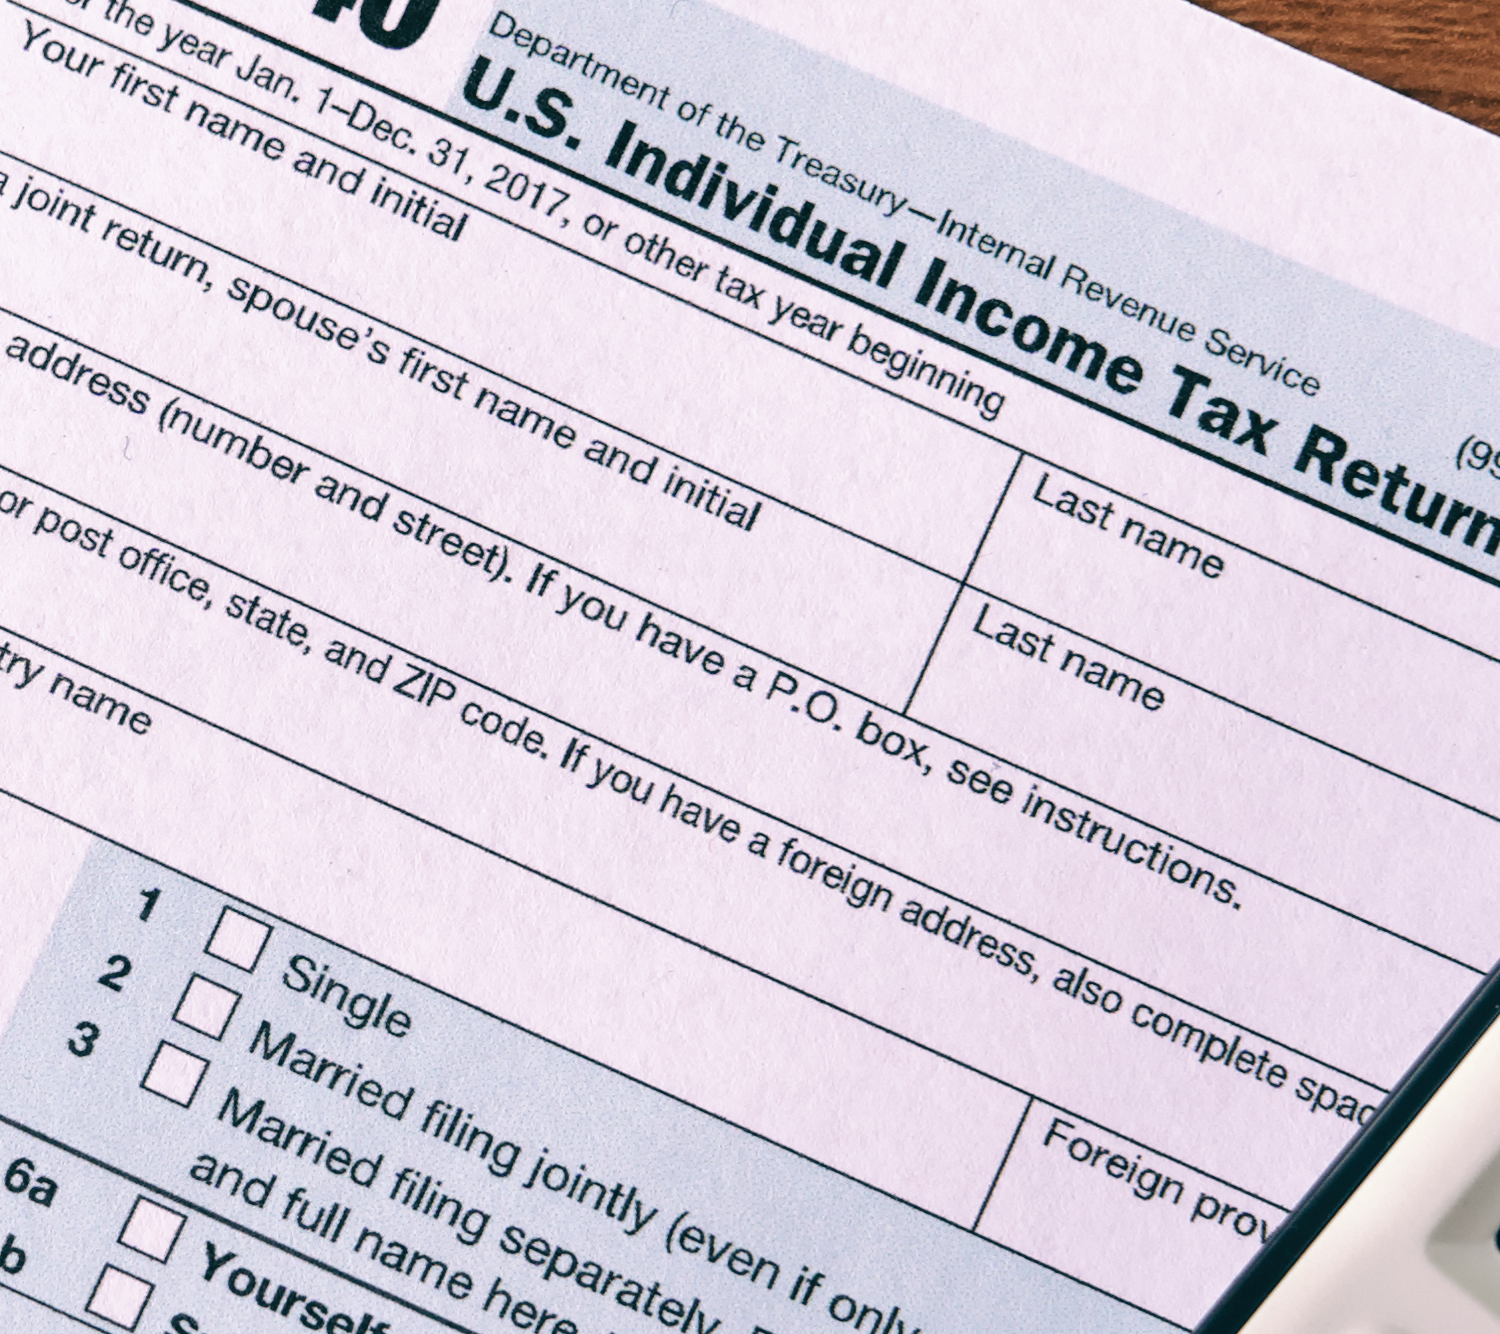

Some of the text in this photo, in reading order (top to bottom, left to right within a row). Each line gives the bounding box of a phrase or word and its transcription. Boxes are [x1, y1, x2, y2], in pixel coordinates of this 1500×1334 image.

[22, 18, 470, 243] Your first name and initial
[155, 23, 234, 69] year
[235, 53, 300, 104] Jan.
[427, 137, 473, 186] 31,
[483, 163, 571, 229] 2017,
[582, 213, 620, 242] or
[623, 231, 711, 283] other
[714, 265, 767, 311] tax
[766, 295, 845, 342] year
[846, 322, 1006, 423] beginning
[488, 9, 672, 112] Department
[676, 100, 714, 128] of
[715, 112, 767, 153] the
[1060, 263, 1197, 343] Revenue
[1204, 327, 1321, 398] Service
[9, 181, 97, 234] joint
[101, 218, 214, 294] return,
[398, 346, 470, 401] first
[472, 387, 577, 450] name
[583, 438, 660, 486] and
[662, 471, 764, 533] initial
[462, 53, 582, 152] U.S.
[604, 118, 909, 290] Individual
[913, 256, 1145, 396] Income
[1168, 362, 1281, 458] Tax
[1032, 471, 1225, 580] Last name
[48, 672, 153, 736] name
[972, 601, 1166, 712] Last name
[138, 887, 413, 1039] 1 Single
[3, 1156, 60, 1209] 6a
[96, 953, 133, 994] 2
[248, 1019, 416, 1122] Married
[420, 1099, 523, 1179] filing
[521, 1146, 660, 1237] jointly
[664, 1210, 781, 1291] (even
[788, 1264, 827, 1307] if
